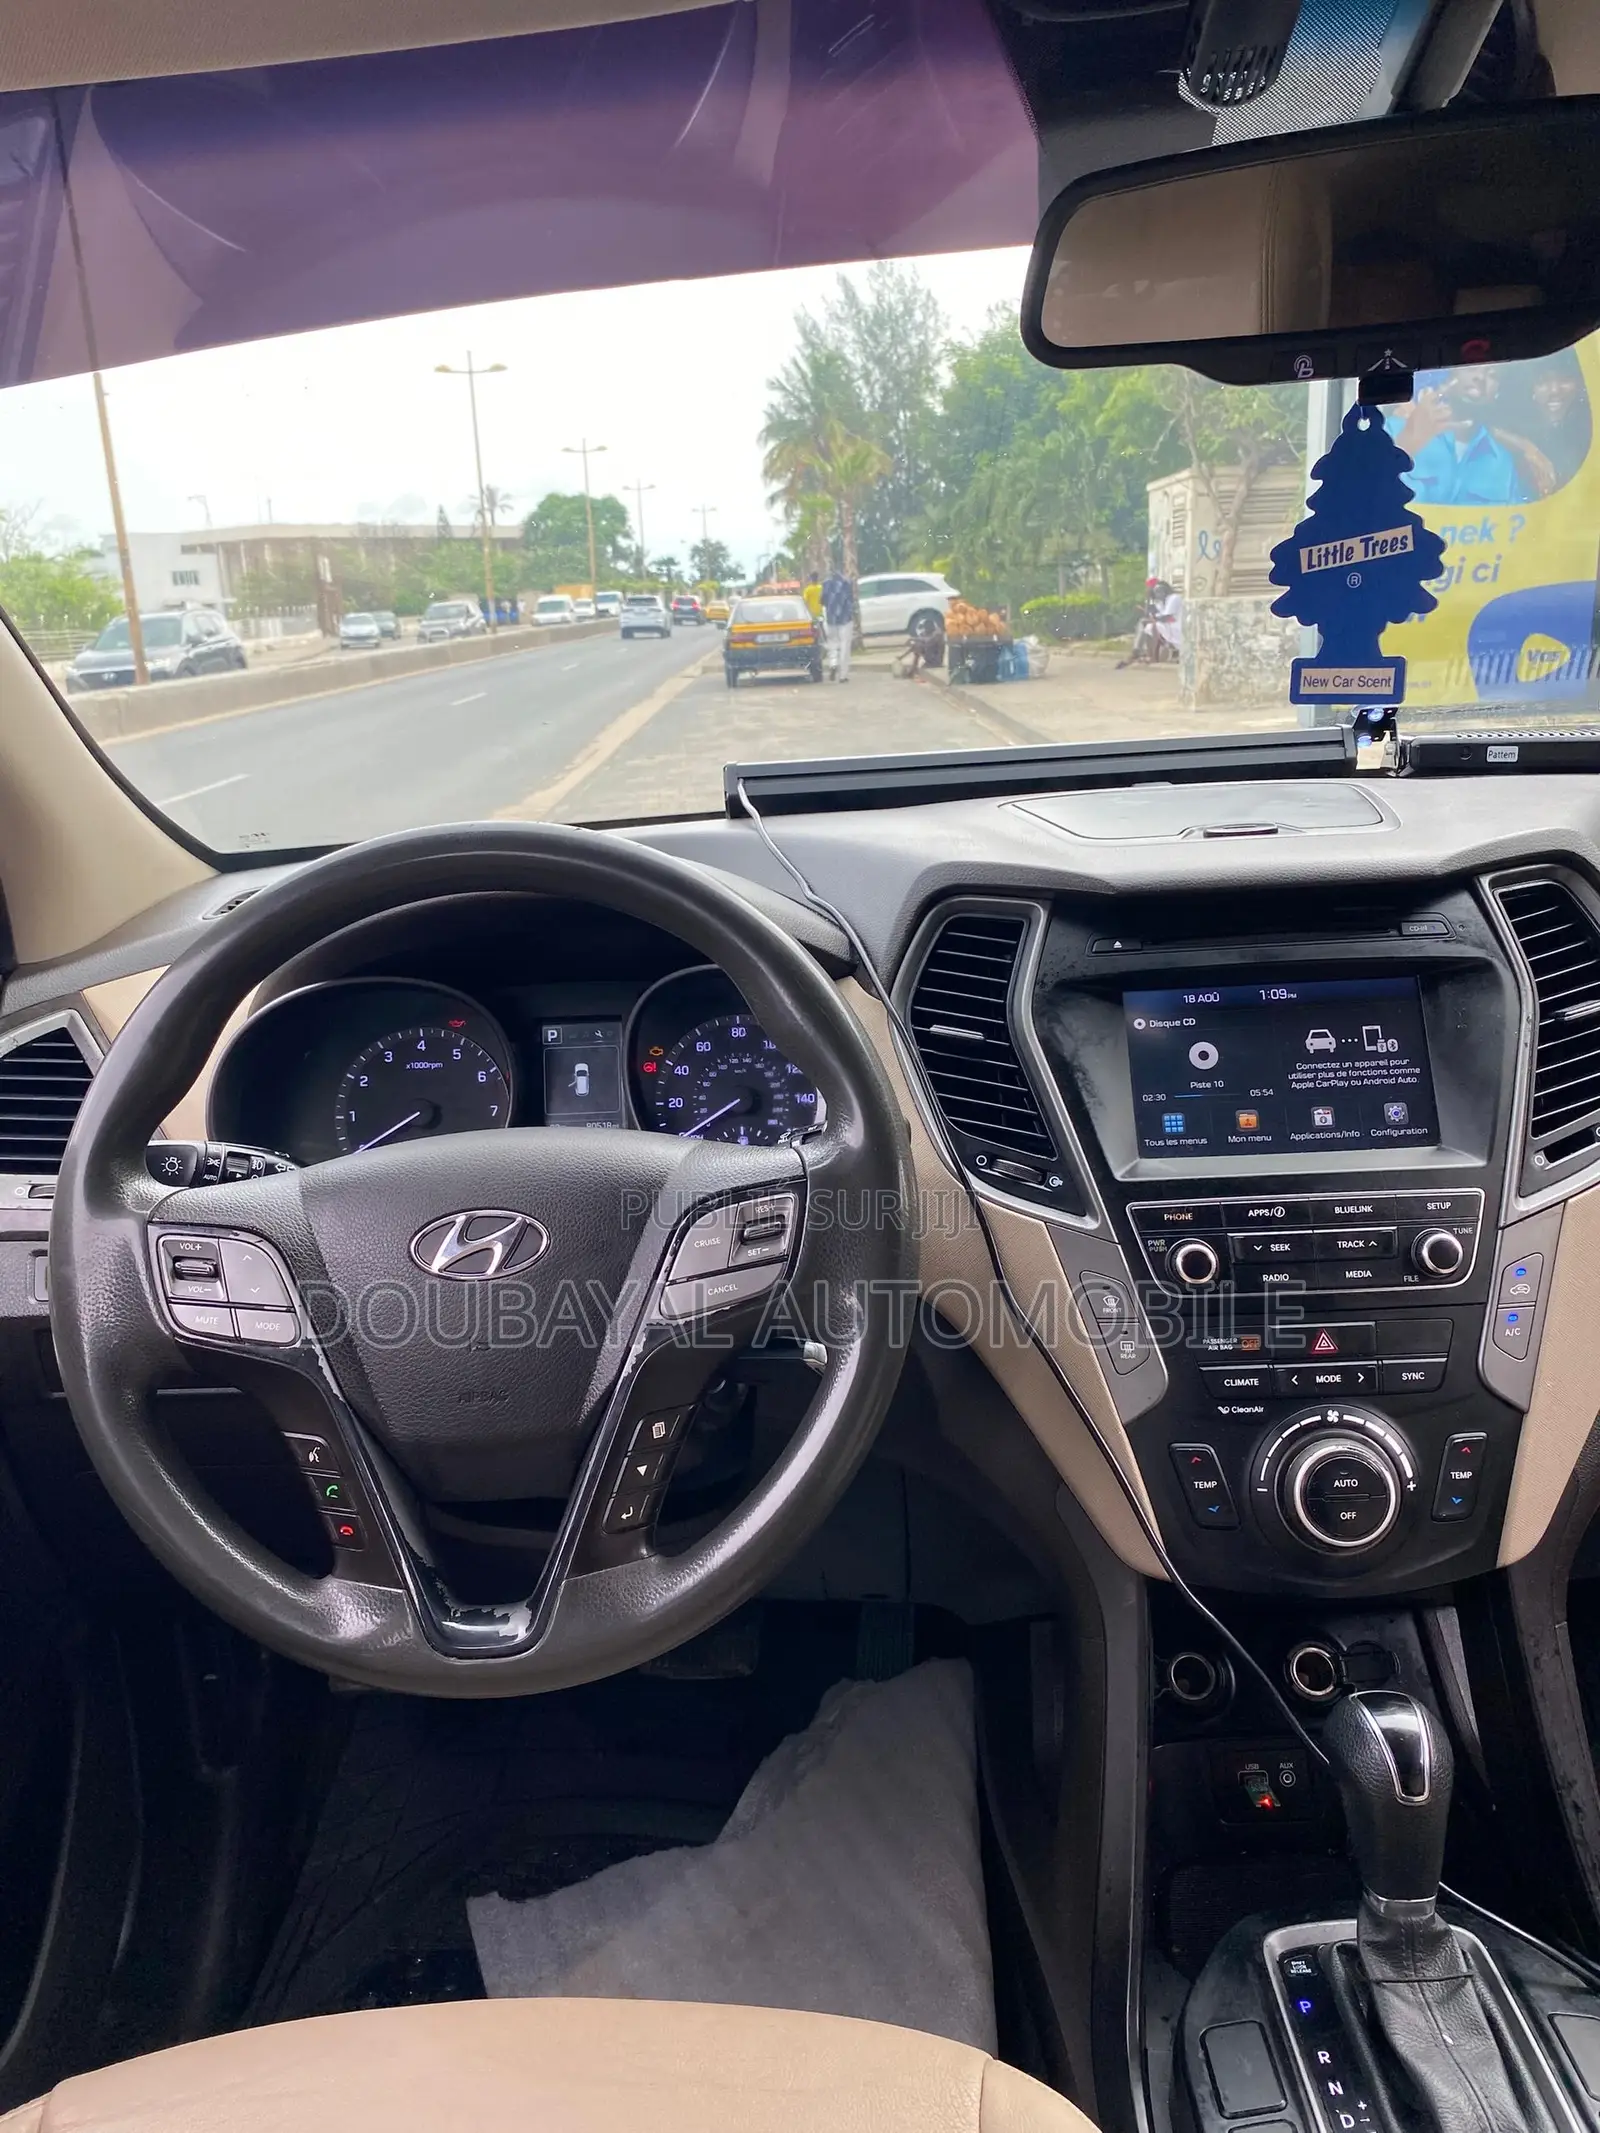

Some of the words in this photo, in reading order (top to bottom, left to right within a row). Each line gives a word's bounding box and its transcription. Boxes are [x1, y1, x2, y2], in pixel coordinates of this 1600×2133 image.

[1307, 543, 1354, 570] Little
[1360, 534, 1409, 559] Trees
[1471, 554, 1503, 583] ci
[1303, 675, 1329, 688] New
[1332, 675, 1354, 688] Car
[1357, 675, 1392, 688] Scent
[1183, 994, 1196, 1004] 18
[1260, 988, 1287, 1000] 1:09
[1149, 1019, 1181, 1030] Disque
[1183, 1017, 1196, 1026] CD
[547, 1029, 558, 1042] P
[731, 1027, 746, 1037] 80
[417, 1040, 426, 1051] 4
[696, 1042, 710, 1052] 60
[384, 1051, 393, 1062] 3
[453, 1049, 462, 1060] 5
[406, 1062, 443, 1070] x1000rpm
[1296, 1062, 1340, 1070] Connectez
[1354, 1059, 1388, 1068] appareil
[1391, 1059, 1409, 1067] pour
[674, 1065, 689, 1076] 40
[1288, 1071, 1316, 1080] utiliser
[1318, 1071, 1335, 1079] plus
[1349, 1068, 1388, 1077] fonctions
[359, 1076, 368, 1087] 2
[477, 1071, 487, 1082] 6
[1190, 1081, 1212, 1089] Piste
[1214, 1080, 1224, 1088] 10
[1291, 1080, 1314, 1089] Apple
[1315, 1079, 1349, 1088] CarPlay
[1363, 1077, 1396, 1085] Android
[794, 1093, 815, 1103] 140
[1250, 1089, 1274, 1097] 05:54
[668, 1097, 683, 1107] 20
[350, 1110, 356, 1122] 1
[490, 1105, 499, 1117] 7
[1370, 1127, 1429, 1137] Configuration
[1144, 1139, 1165, 1147] Tous
[1179, 1137, 1208, 1145] menus
[1228, 1134, 1247, 1143] Mon
[1248, 1134, 1272, 1142] menu
[203, 1174, 218, 1182] AUTO
[1334, 1205, 1374, 1214] BLUELINK
[1426, 1202, 1451, 1210] SETUP
[1164, 1213, 1194, 1221] PHONE
[1453, 1227, 1473, 1235] TUNE
[179, 1242, 202, 1251] VOL+
[694, 1237, 721, 1248] CRUISE
[1147, 1239, 1166, 1247] PWR
[1337, 1241, 1365, 1249] TRACK
[1270, 1244, 1291, 1252] SEEK
[1262, 1274, 1289, 1283] RADIO
[1345, 1270, 1373, 1279] MEDIA
[1403, 1275, 1420, 1283] FILE
[707, 1283, 739, 1296] CANCEL
[194, 1316, 219, 1325] MUTE
[255, 1321, 281, 1331] MODE
[1505, 1328, 1521, 1336] A/C
[1316, 1374, 1342, 1384] MODE
[1401, 1371, 1426, 1381] SYNC
[1224, 1379, 1259, 1387] CLIMATE
[1450, 1471, 1473, 1480] TEMP
[1193, 1481, 1218, 1489] TEMP
[1333, 1479, 1359, 1488] AUTO
[1340, 1511, 1357, 1521] OFF
[1300, 2001, 1312, 2014] P
[1317, 2051, 1332, 2065] R
[1328, 2081, 1344, 2096] N
[1339, 2114, 1355, 2129] D
